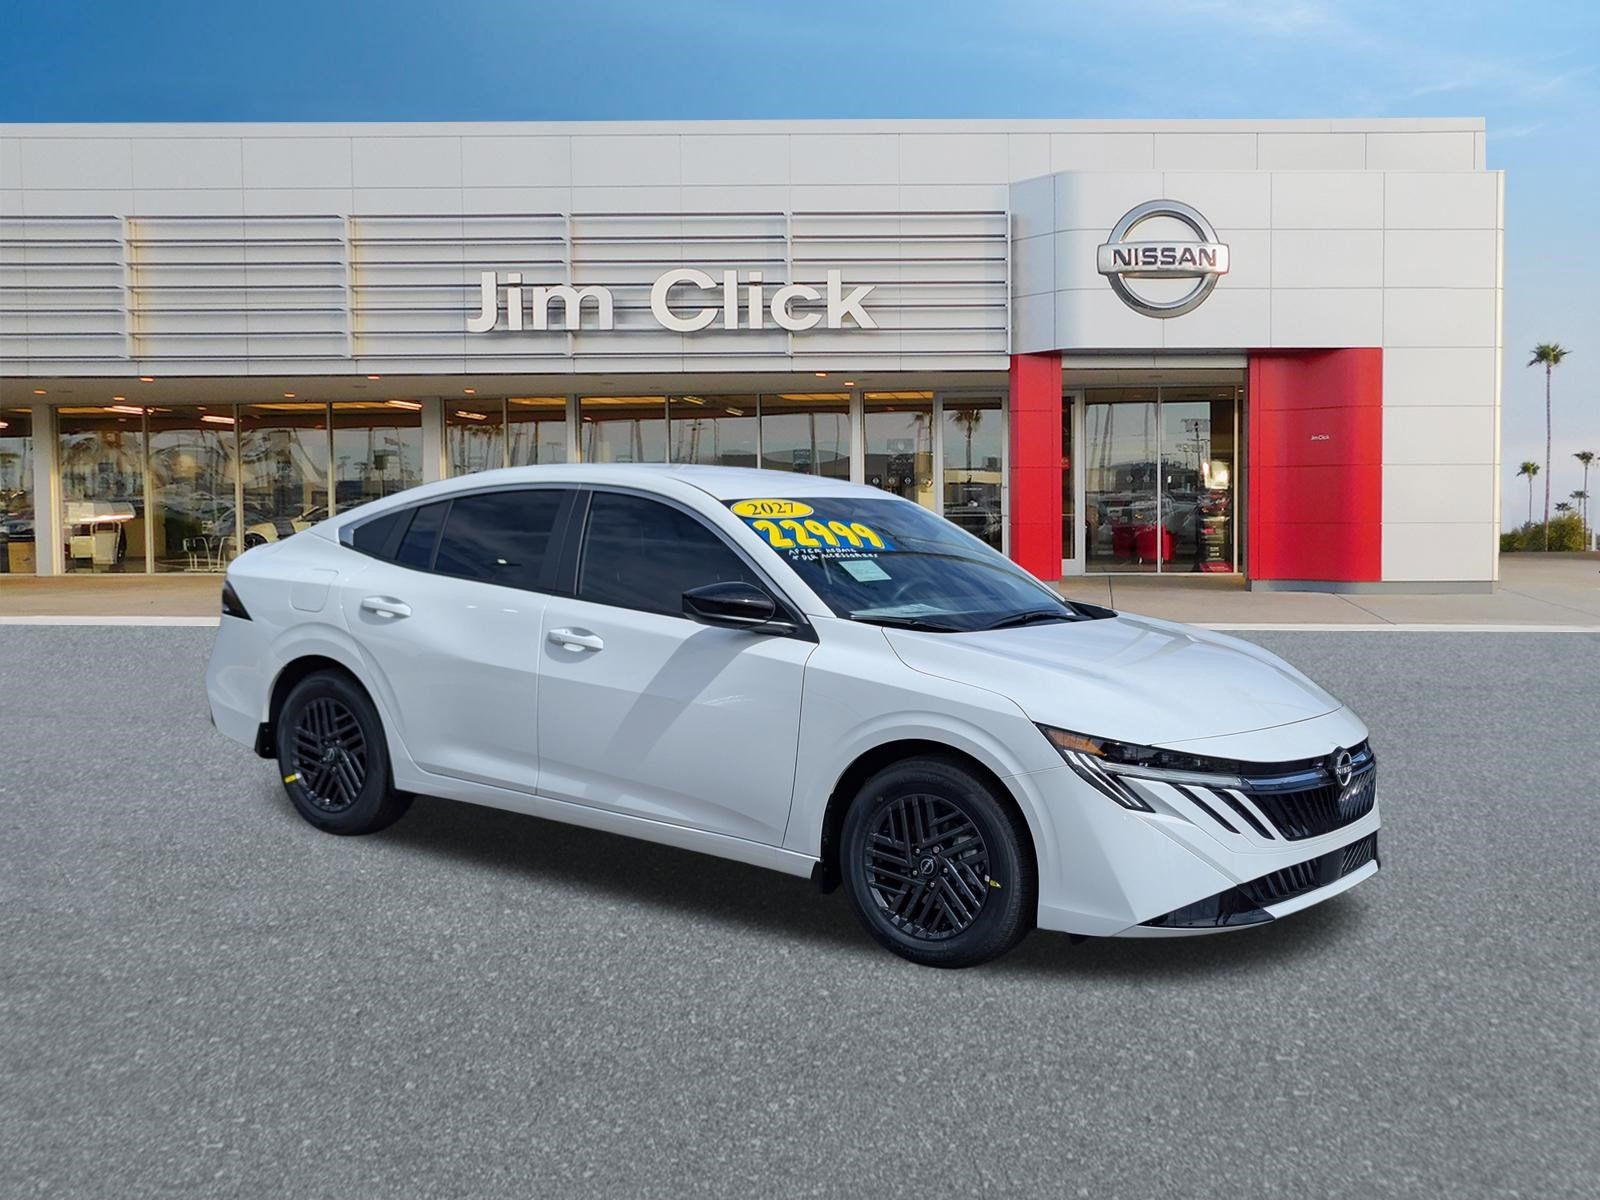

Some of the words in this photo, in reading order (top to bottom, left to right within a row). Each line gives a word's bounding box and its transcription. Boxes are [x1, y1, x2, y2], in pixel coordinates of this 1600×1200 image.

[1113, 247, 1216, 266] NISSAN
[467, 271, 614, 332] Jim
[651, 268, 879, 332] Click
[747, 502, 794, 516] 2027
[753, 519, 885, 548] 22999
